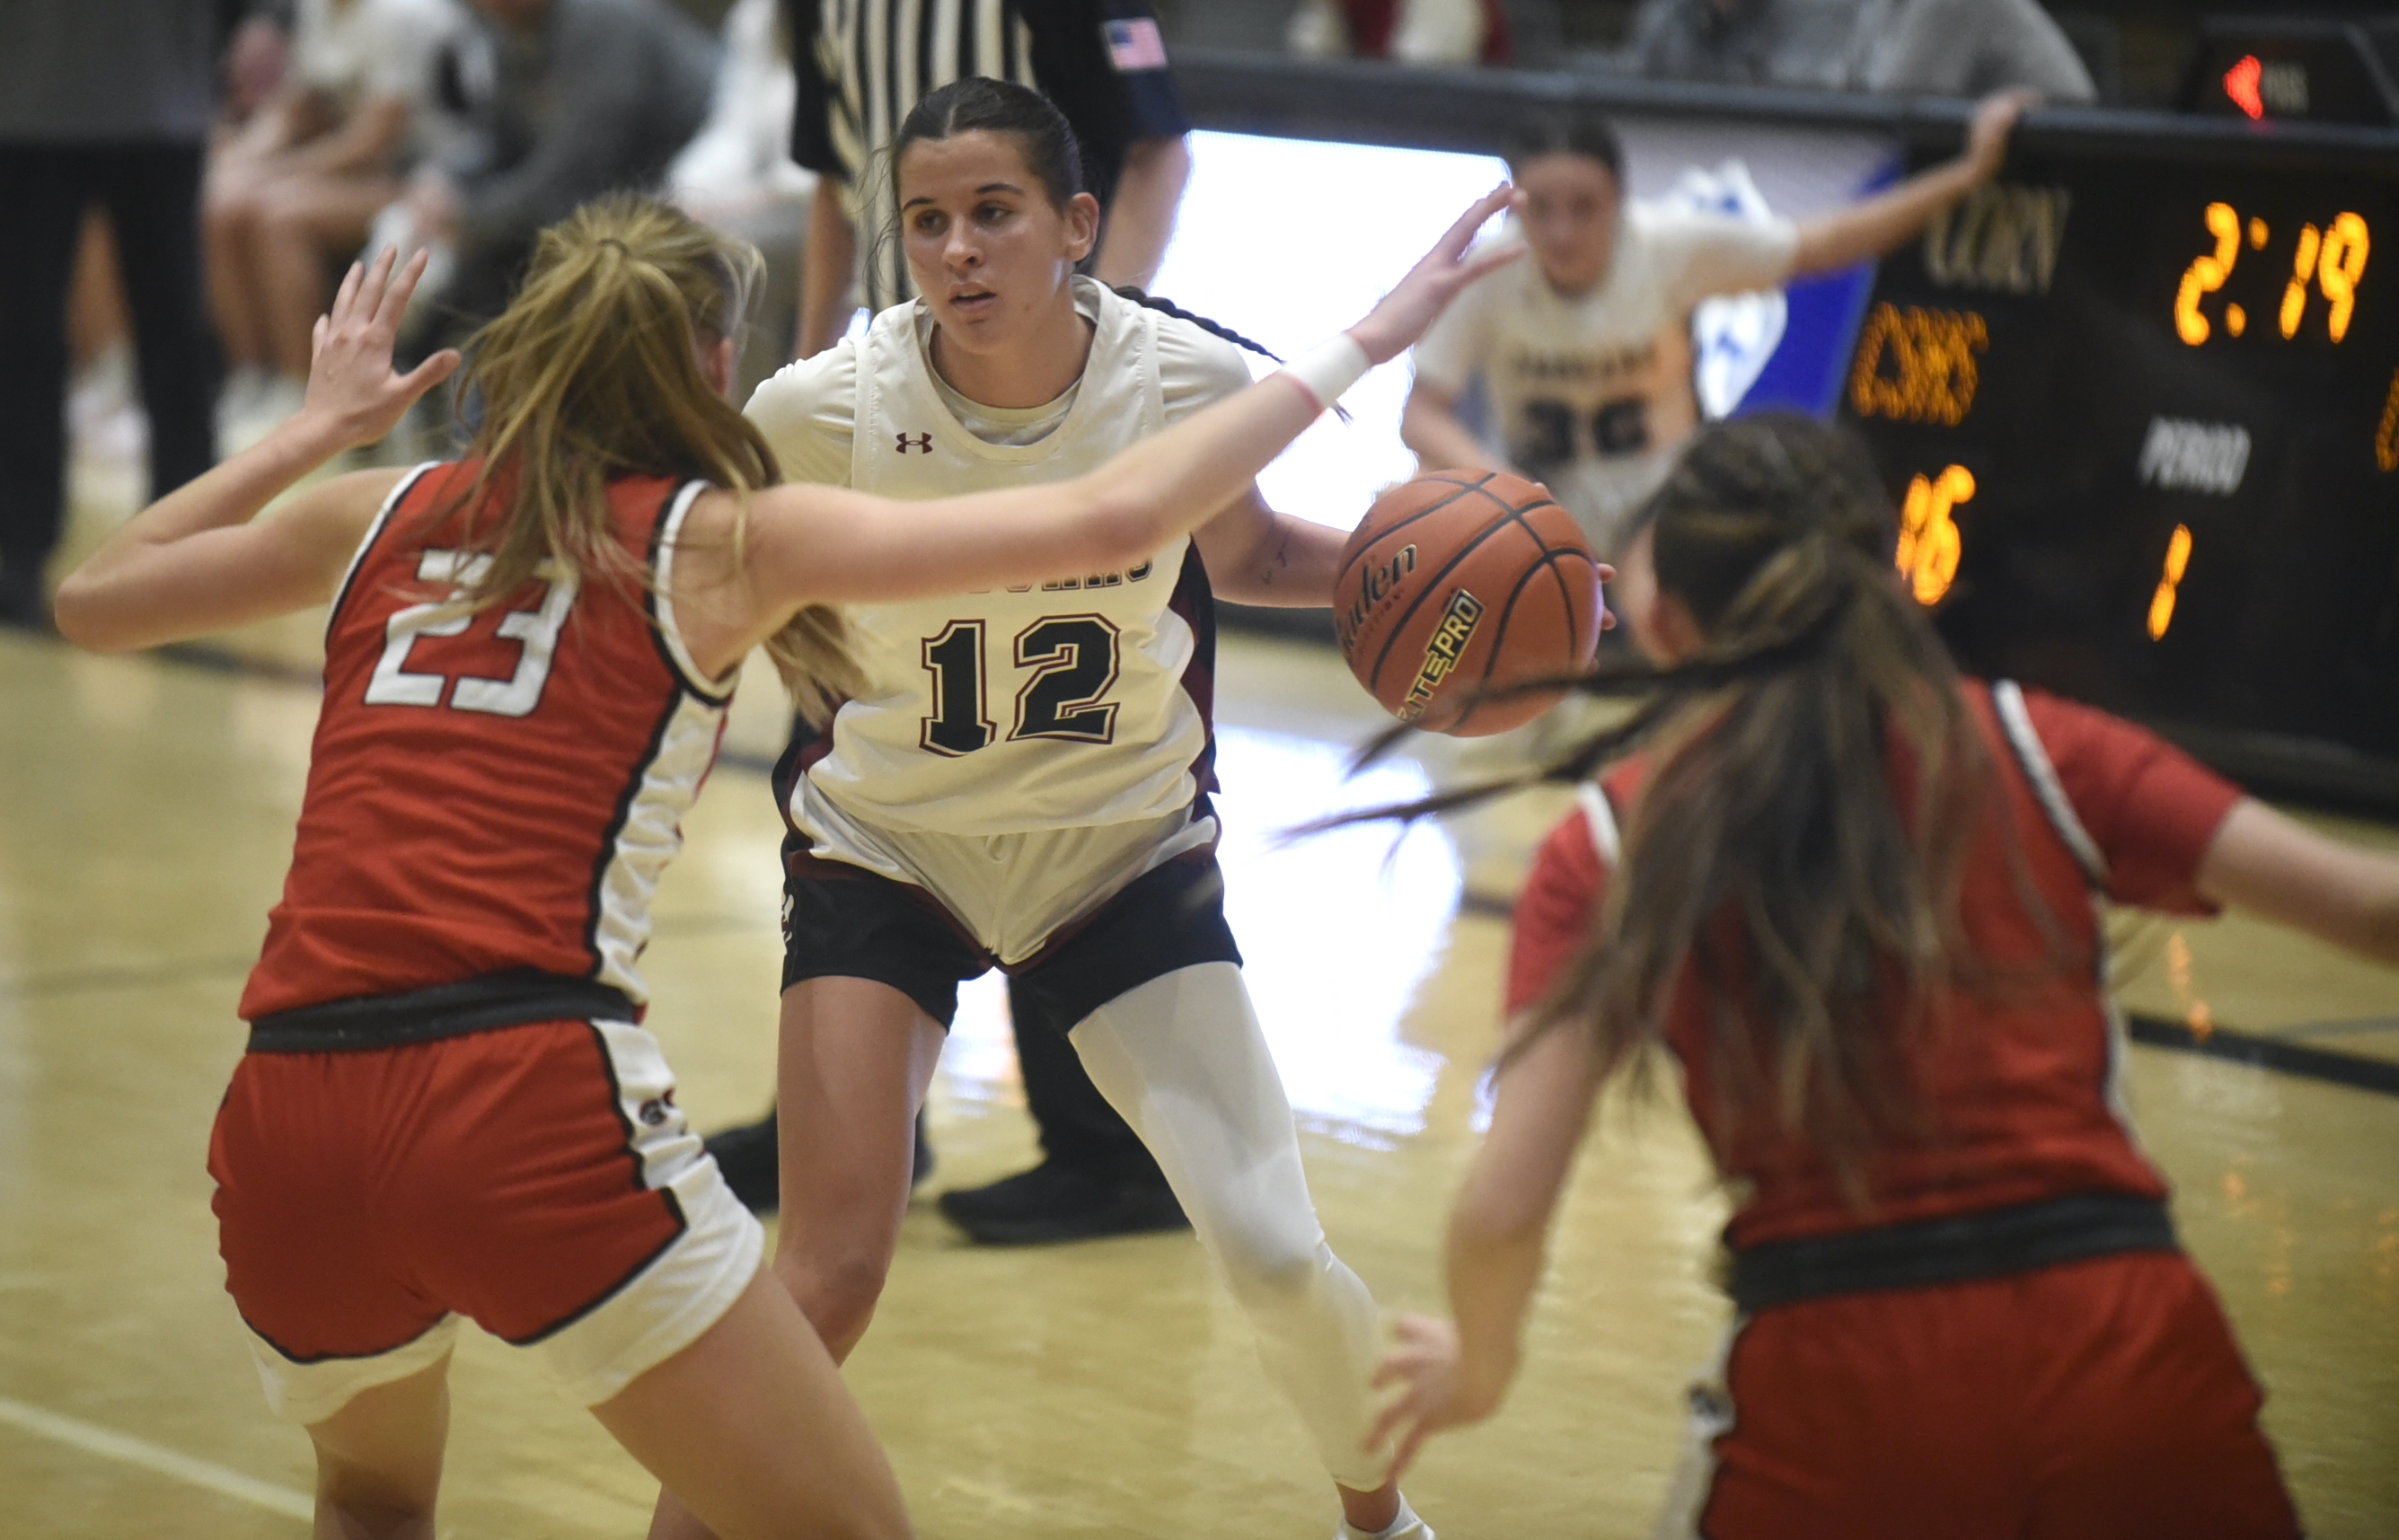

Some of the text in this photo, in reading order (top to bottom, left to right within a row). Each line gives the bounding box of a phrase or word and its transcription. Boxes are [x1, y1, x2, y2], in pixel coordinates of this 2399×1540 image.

[2174, 202, 2370, 346] 2:19
[364, 549, 580, 717] 23
[1434, 594, 1479, 658] PRO
[2147, 524, 2192, 641] 1
[920, 613, 1121, 757] 12
